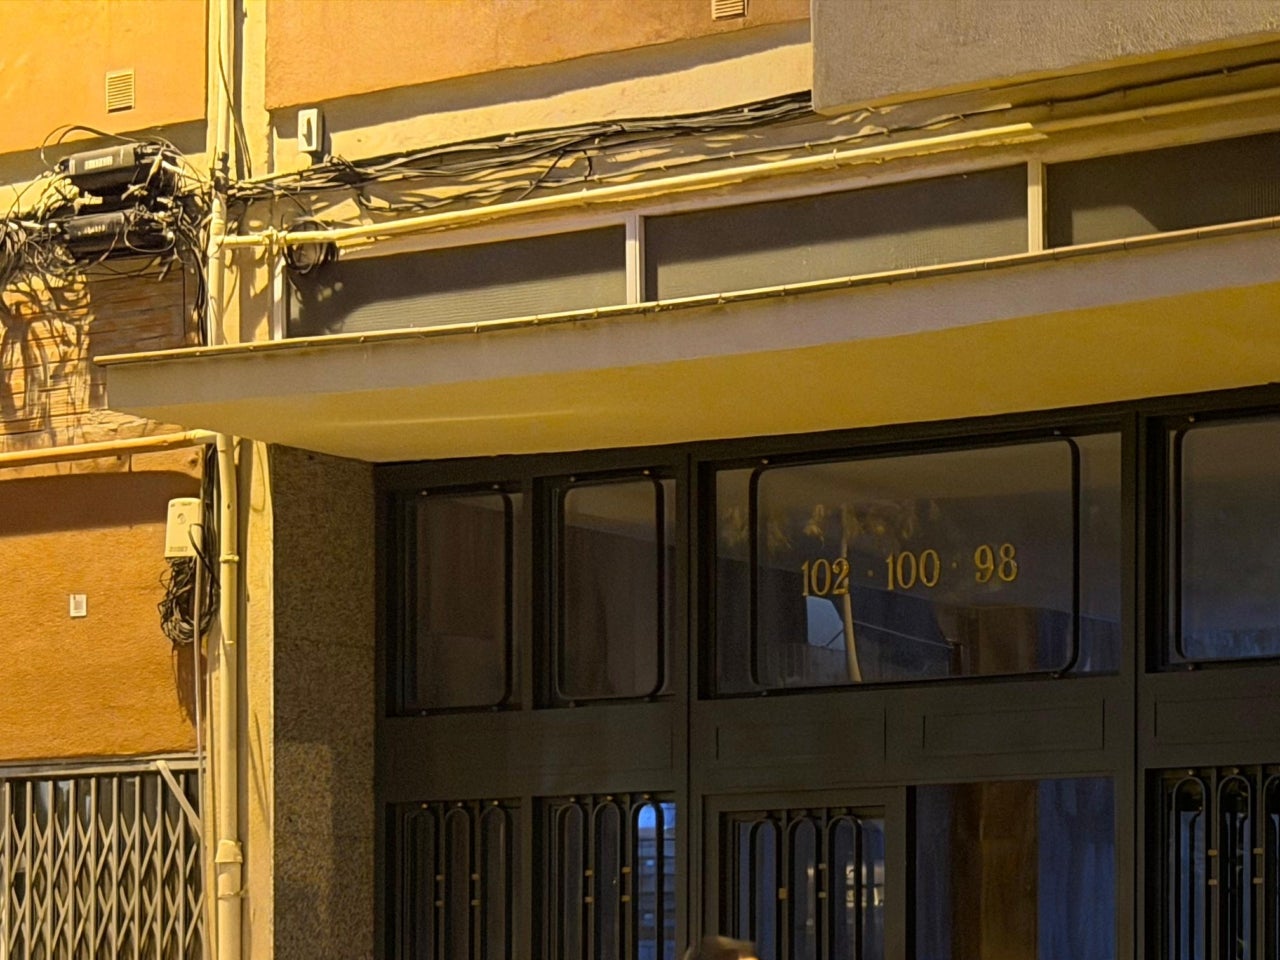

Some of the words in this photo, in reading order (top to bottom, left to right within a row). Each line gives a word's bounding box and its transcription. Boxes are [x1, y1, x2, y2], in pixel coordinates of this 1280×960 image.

[801, 557, 849, 597] 102
[886, 549, 941, 591] 100
[973, 543, 1018, 583] 98
